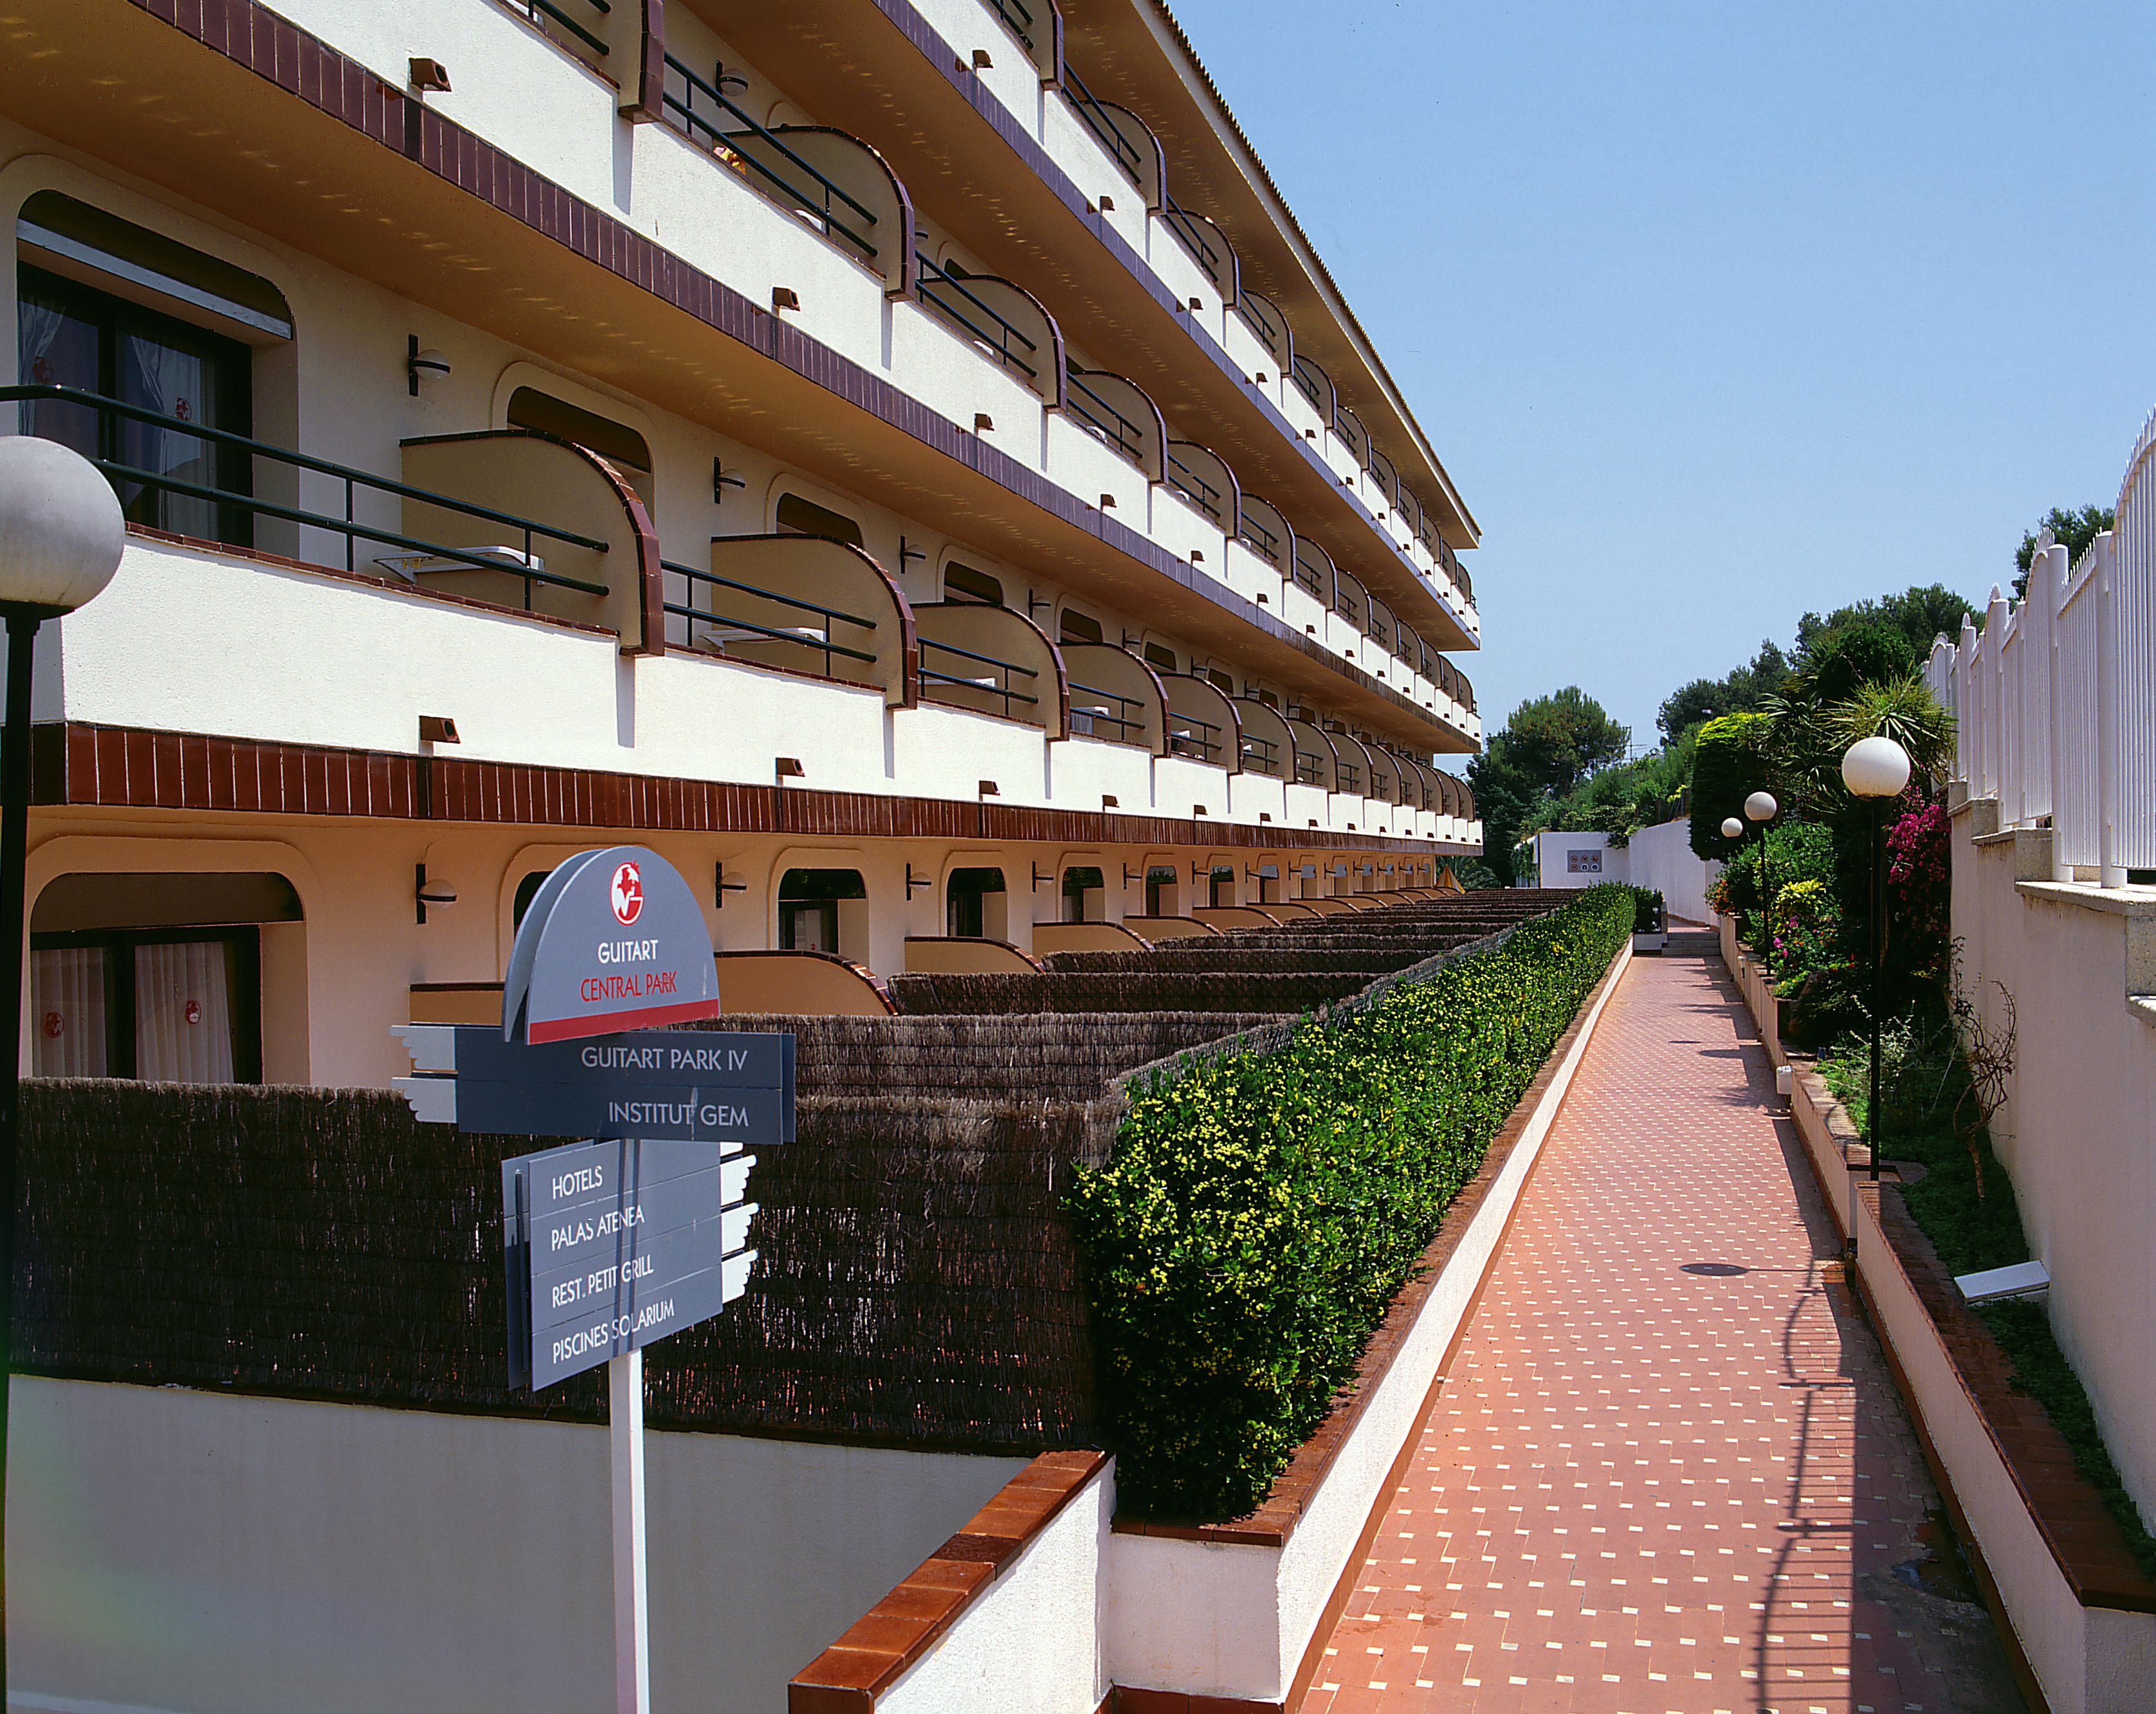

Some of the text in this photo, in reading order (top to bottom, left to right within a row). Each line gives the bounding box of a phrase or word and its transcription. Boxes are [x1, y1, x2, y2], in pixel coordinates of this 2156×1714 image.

[598, 939, 659, 963] GUITART
[581, 971, 677, 1002] CENTRAL PARK
[581, 1046, 747, 1071] GUITART PARK IV
[608, 1101, 749, 1127] INSTITUT GEM
[552, 1165, 603, 1199] HOTELS
[551, 1205, 645, 1252] PALAS ATENEA
[552, 1254, 654, 1308] REST. PETIT GRILL
[553, 1298, 675, 1364] PISCINES SOLARIUM
